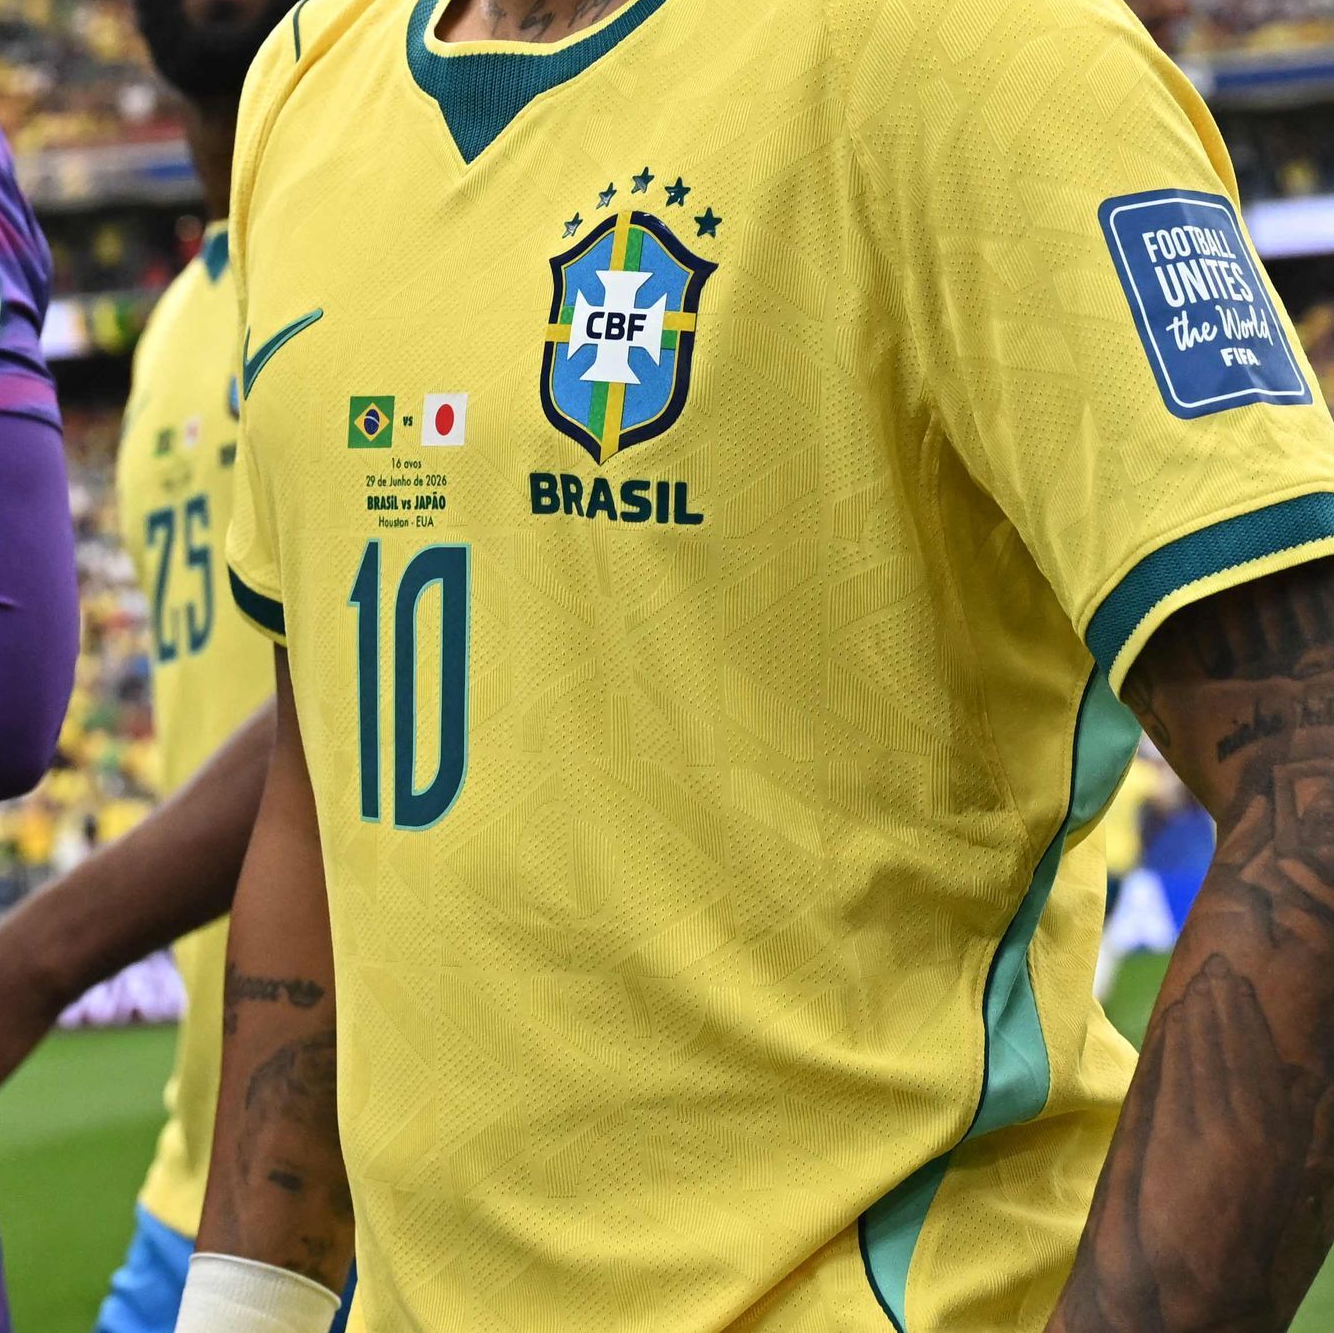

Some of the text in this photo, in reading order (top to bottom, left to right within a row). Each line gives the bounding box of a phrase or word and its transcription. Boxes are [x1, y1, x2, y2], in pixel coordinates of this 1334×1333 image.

[1142, 226, 1236, 263] FOOTBALL
[1154, 258, 1253, 307] UNITES
[586, 311, 647, 341] CBF
[1166, 305, 1273, 351] the World
[1220, 347, 1260, 367] FIFA
[403, 416, 413, 426] vs
[391, 458, 422, 469] 16 avos
[366, 474, 447, 487] 29 de Junho de 2026
[401, 499, 412, 510] vs
[414, 492, 446, 510] JAPÃO
[529, 472, 704, 525] BRASIL
[378, 516, 409, 528] Houston
[416, 516, 434, 527] EUA
[146, 492, 214, 662] 25
[347, 538, 471, 831] 10
